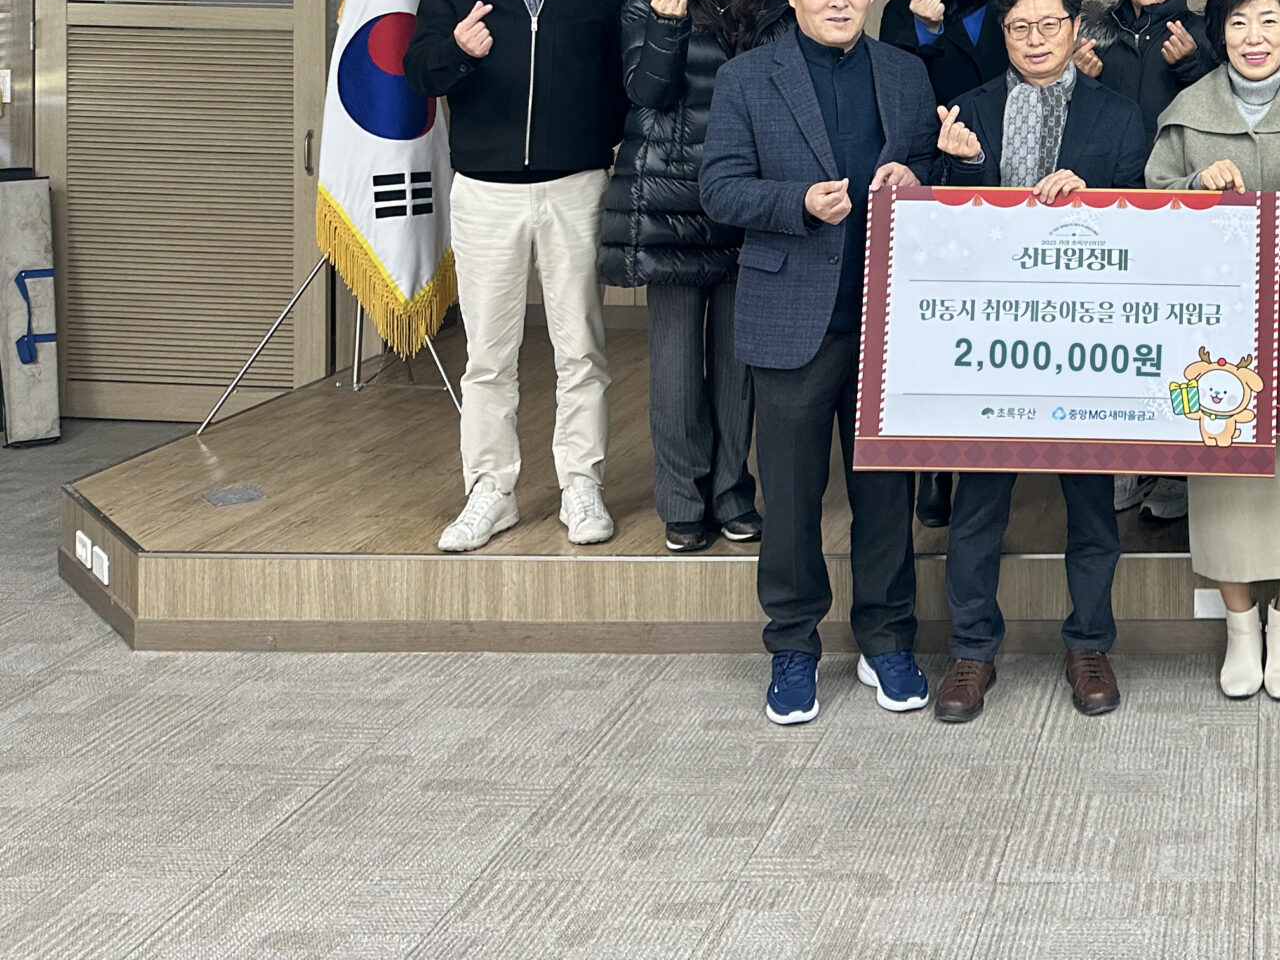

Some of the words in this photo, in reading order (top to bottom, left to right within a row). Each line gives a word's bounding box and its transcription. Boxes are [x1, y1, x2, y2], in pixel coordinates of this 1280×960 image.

[1014, 247, 1132, 272] 산타원정대
[919, 299, 976, 321] 안동시
[981, 299, 1116, 324] 취약계층아동을
[1121, 301, 1159, 324] 위한
[1166, 302, 1223, 326] 지원금
[954, 338, 1163, 377] 2,000,000원
[997, 407, 1036, 420] 초록우산
